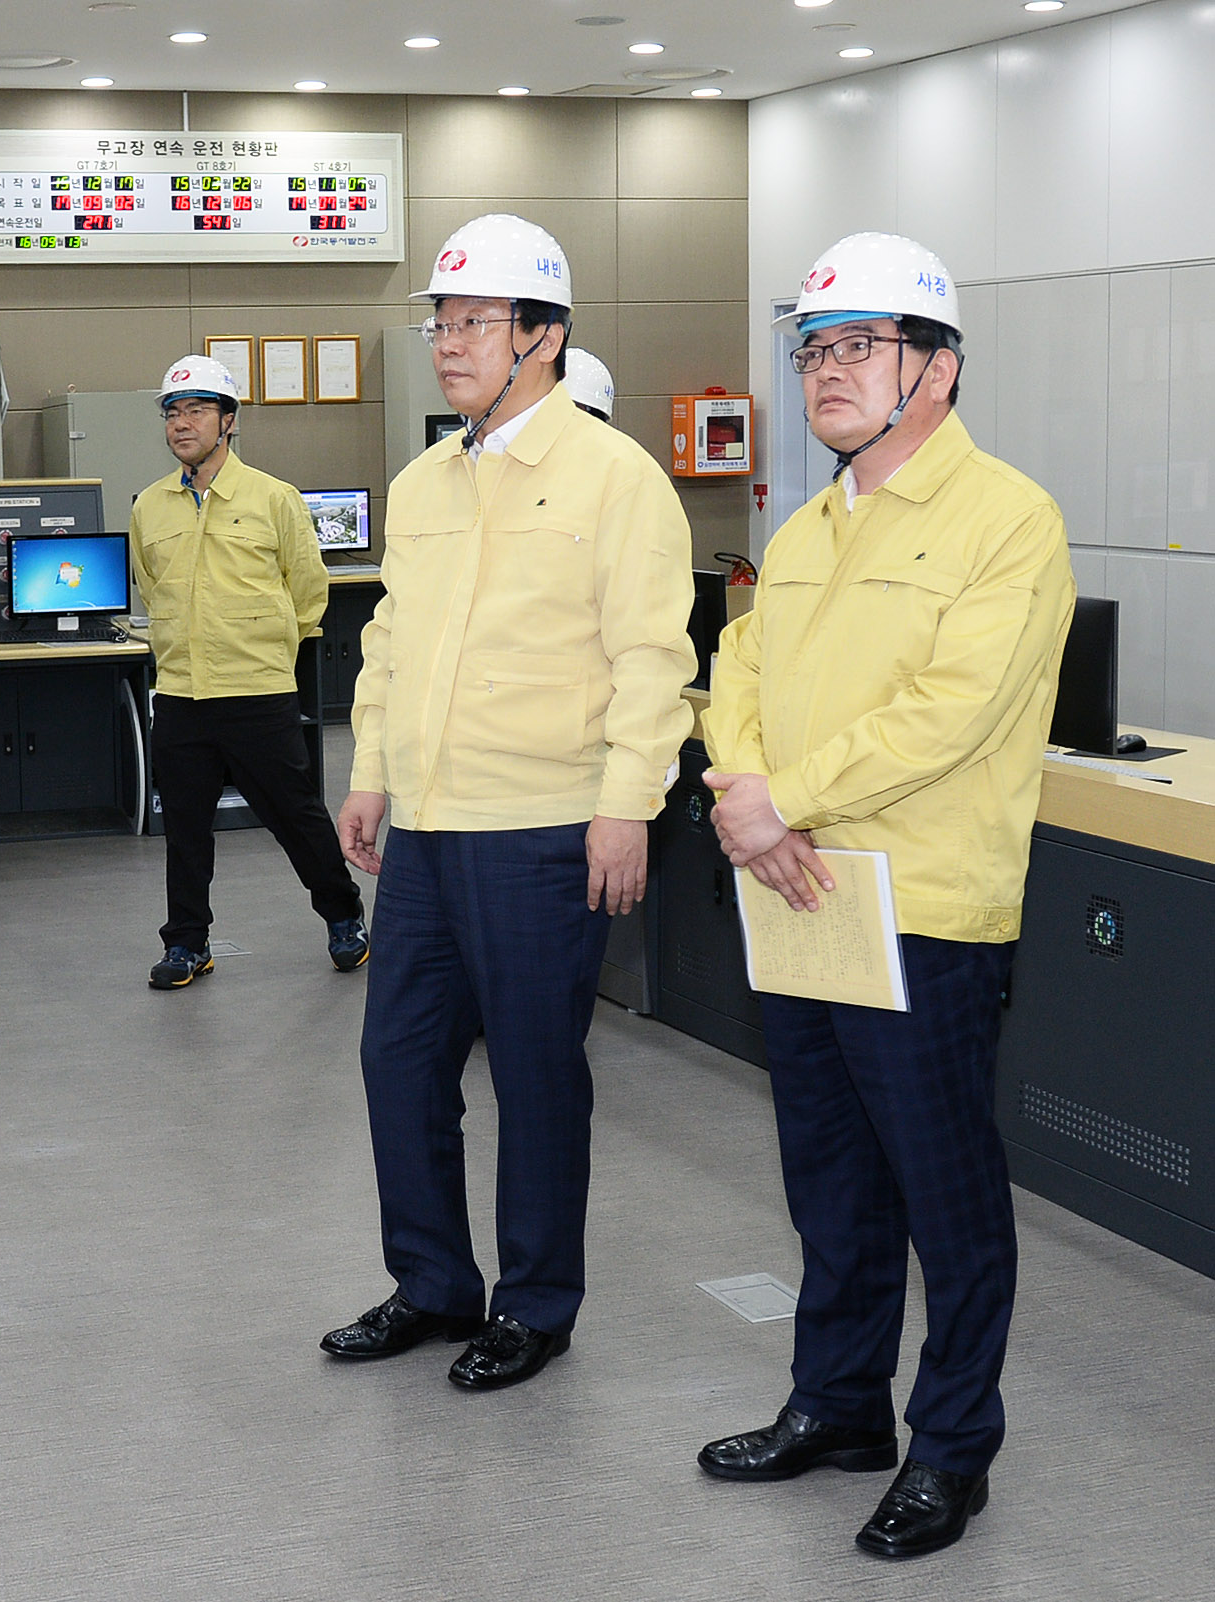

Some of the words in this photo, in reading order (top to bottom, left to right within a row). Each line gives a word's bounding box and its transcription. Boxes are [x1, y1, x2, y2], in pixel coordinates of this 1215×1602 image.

[97, 140, 145, 156] 무고장
[153, 140, 184, 156] 연속
[192, 140, 224, 156] 운전
[232, 141, 278, 157] 현황판
[76, 160, 90, 170] GT
[196, 161, 210, 171] GT
[313, 162, 325, 171] ST
[537, 257, 561, 279] 내빈
[917, 271, 946, 297] 사장
[674, 459, 687, 470] AED
